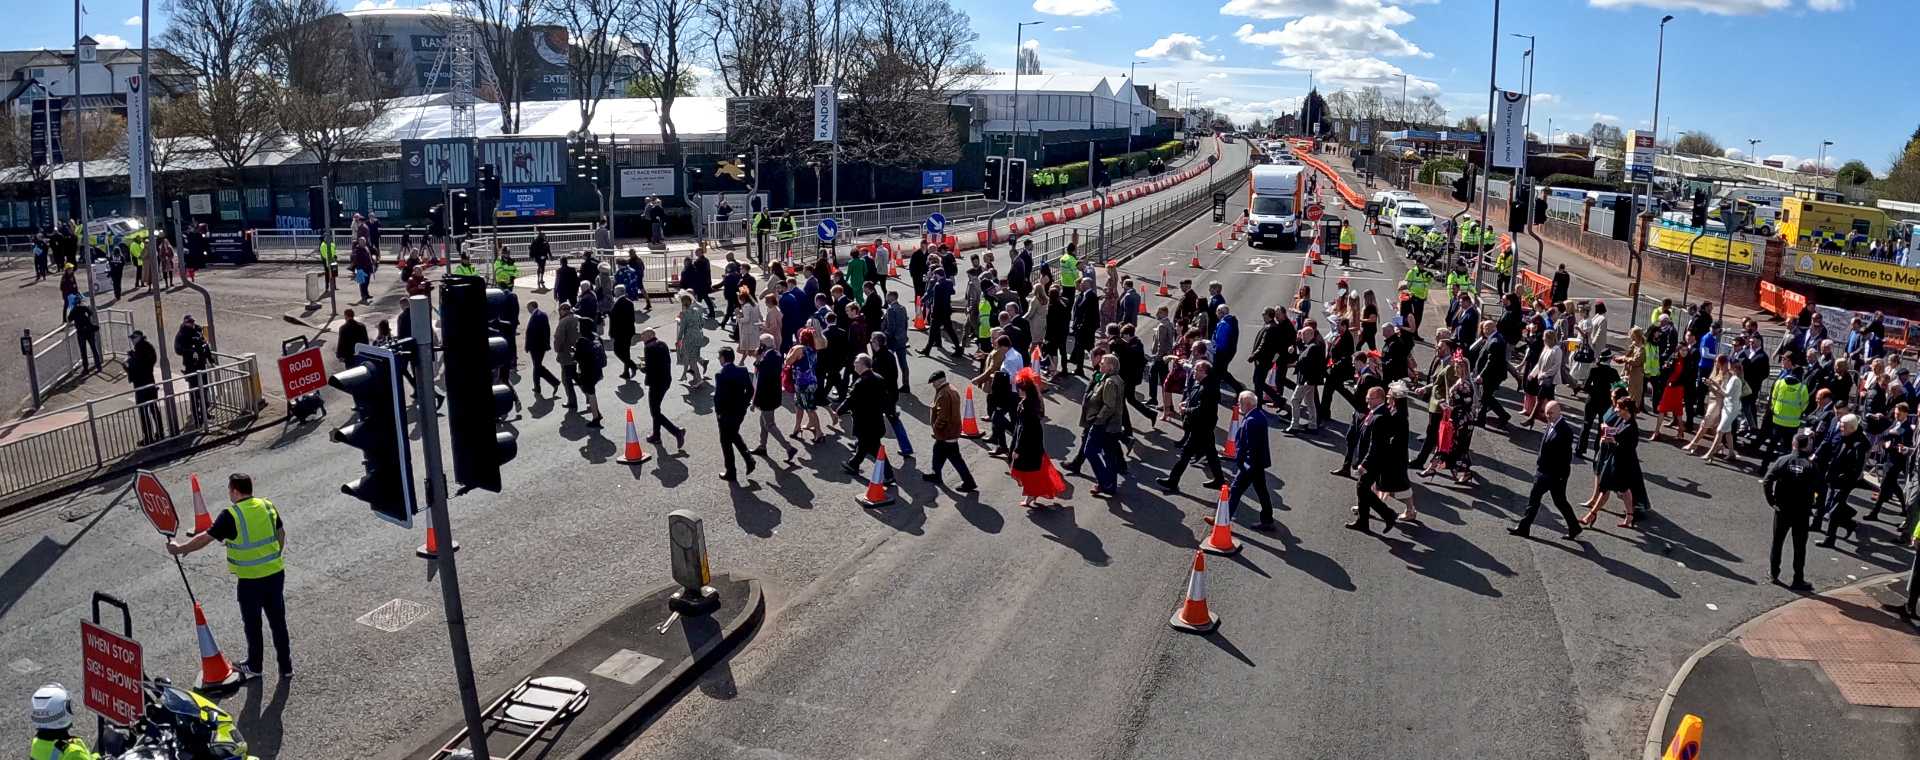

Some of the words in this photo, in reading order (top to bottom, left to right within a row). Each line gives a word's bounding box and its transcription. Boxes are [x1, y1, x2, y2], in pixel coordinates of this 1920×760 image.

[820, 90, 829, 138] RANDOX
[423, 143, 469, 185] GRAND
[484, 141, 562, 183] NATIONAL
[1819, 260, 1877, 279] Welcome
[1880, 271, 1893, 282] to
[289, 358, 313, 373] ROAD
[289, 372, 321, 390] CLOSED
[143, 492, 170, 515] STOP
[87, 633, 110, 655] WHEN
[112, 644, 135, 664] STOP
[86, 658, 104, 678] SIGN
[106, 668, 139, 694] SHOWS
[90, 687, 110, 707] WAIT
[112, 697, 137, 721] HERE
